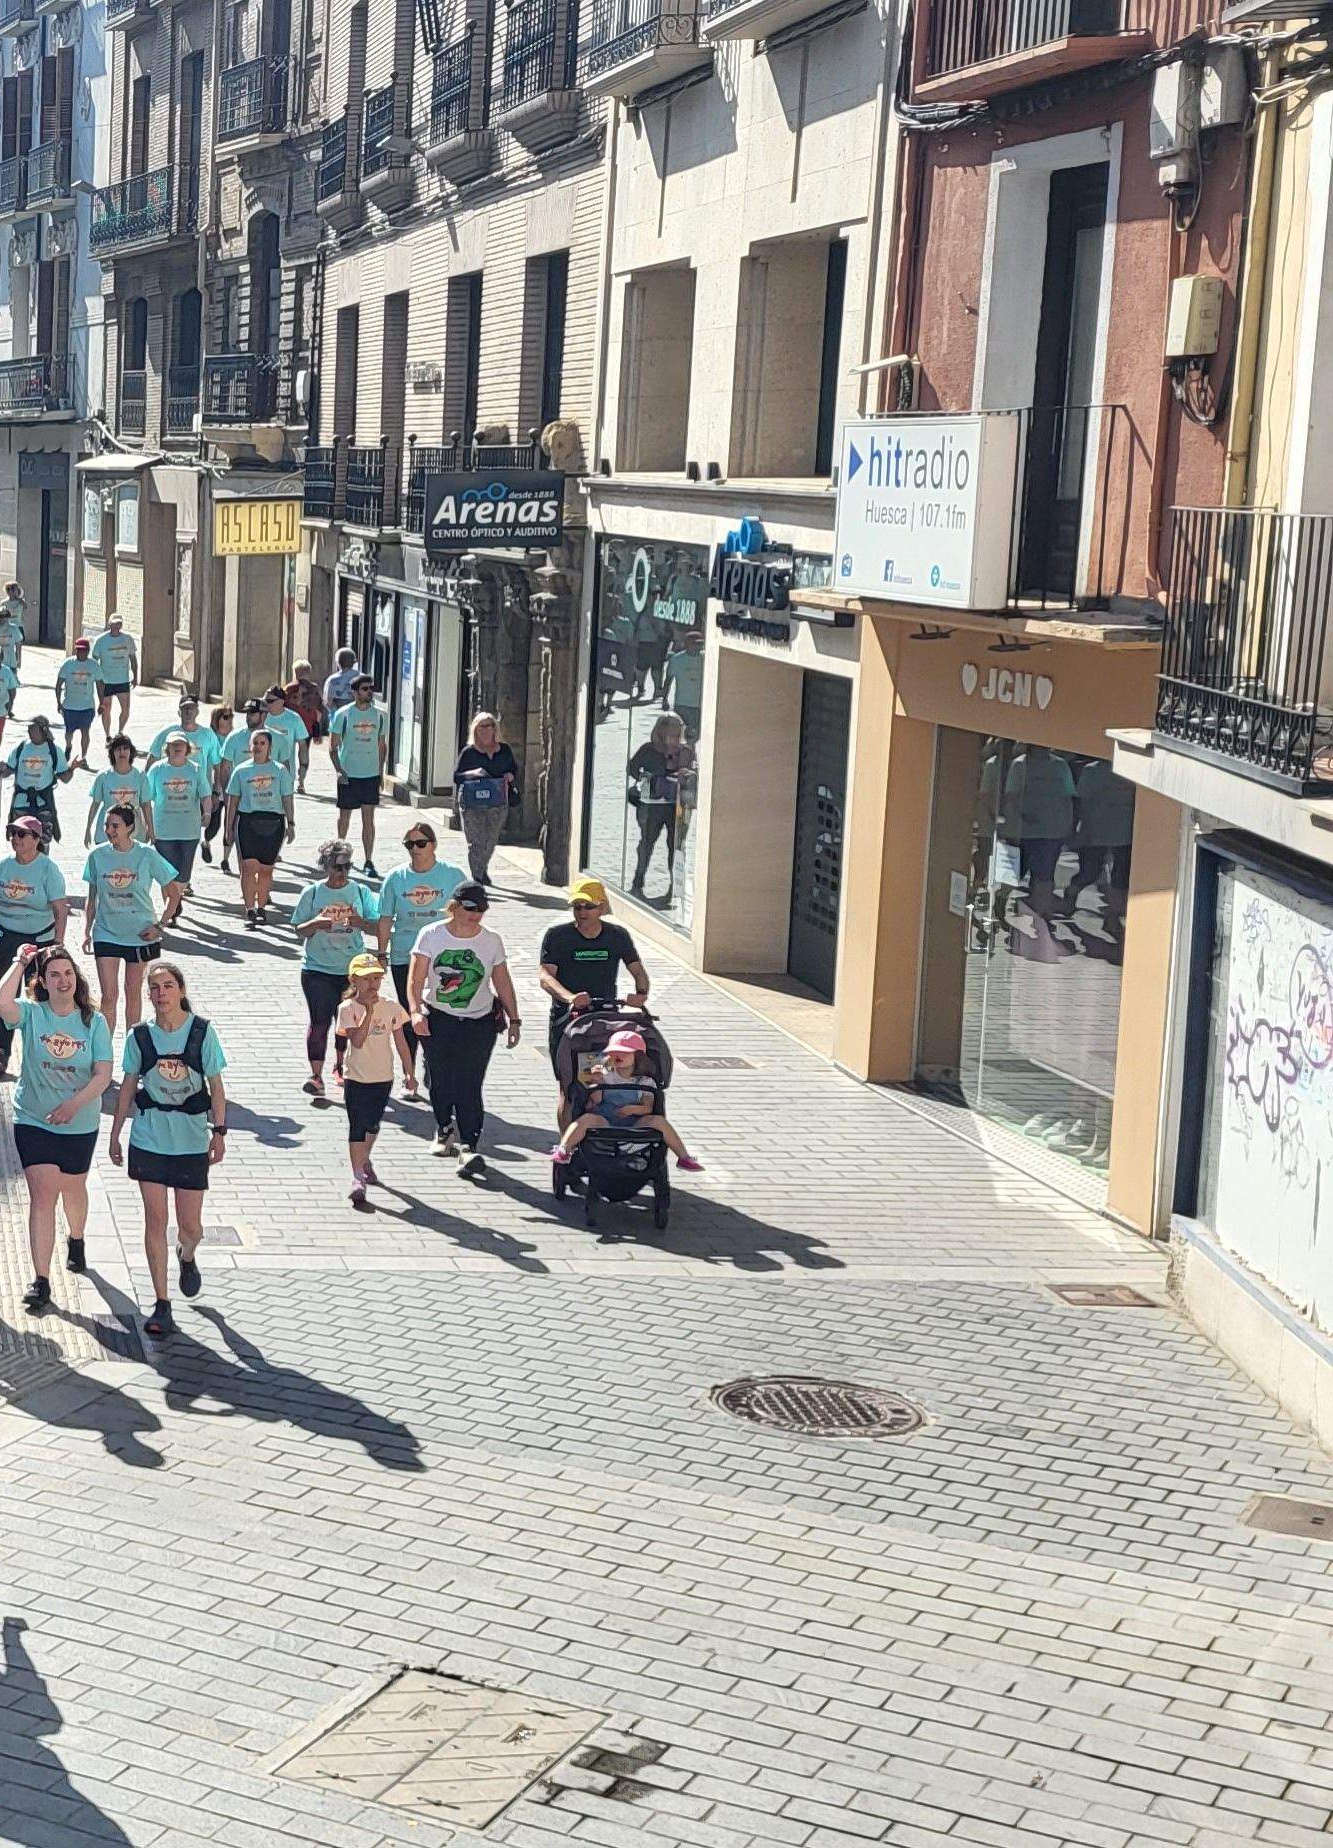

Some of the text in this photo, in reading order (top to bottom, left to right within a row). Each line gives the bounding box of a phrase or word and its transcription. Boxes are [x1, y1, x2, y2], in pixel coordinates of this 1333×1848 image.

[868, 435, 970, 491] hitradio
[221, 503, 295, 544] ASCASO
[432, 495, 558, 525] Arenas
[865, 499, 907, 526] Huesca
[919, 504, 967, 530] 107.1fm
[432, 526, 558, 538] CENTRO ÓPTICO Y AUDITIVO
[675, 598, 696, 626] 1888
